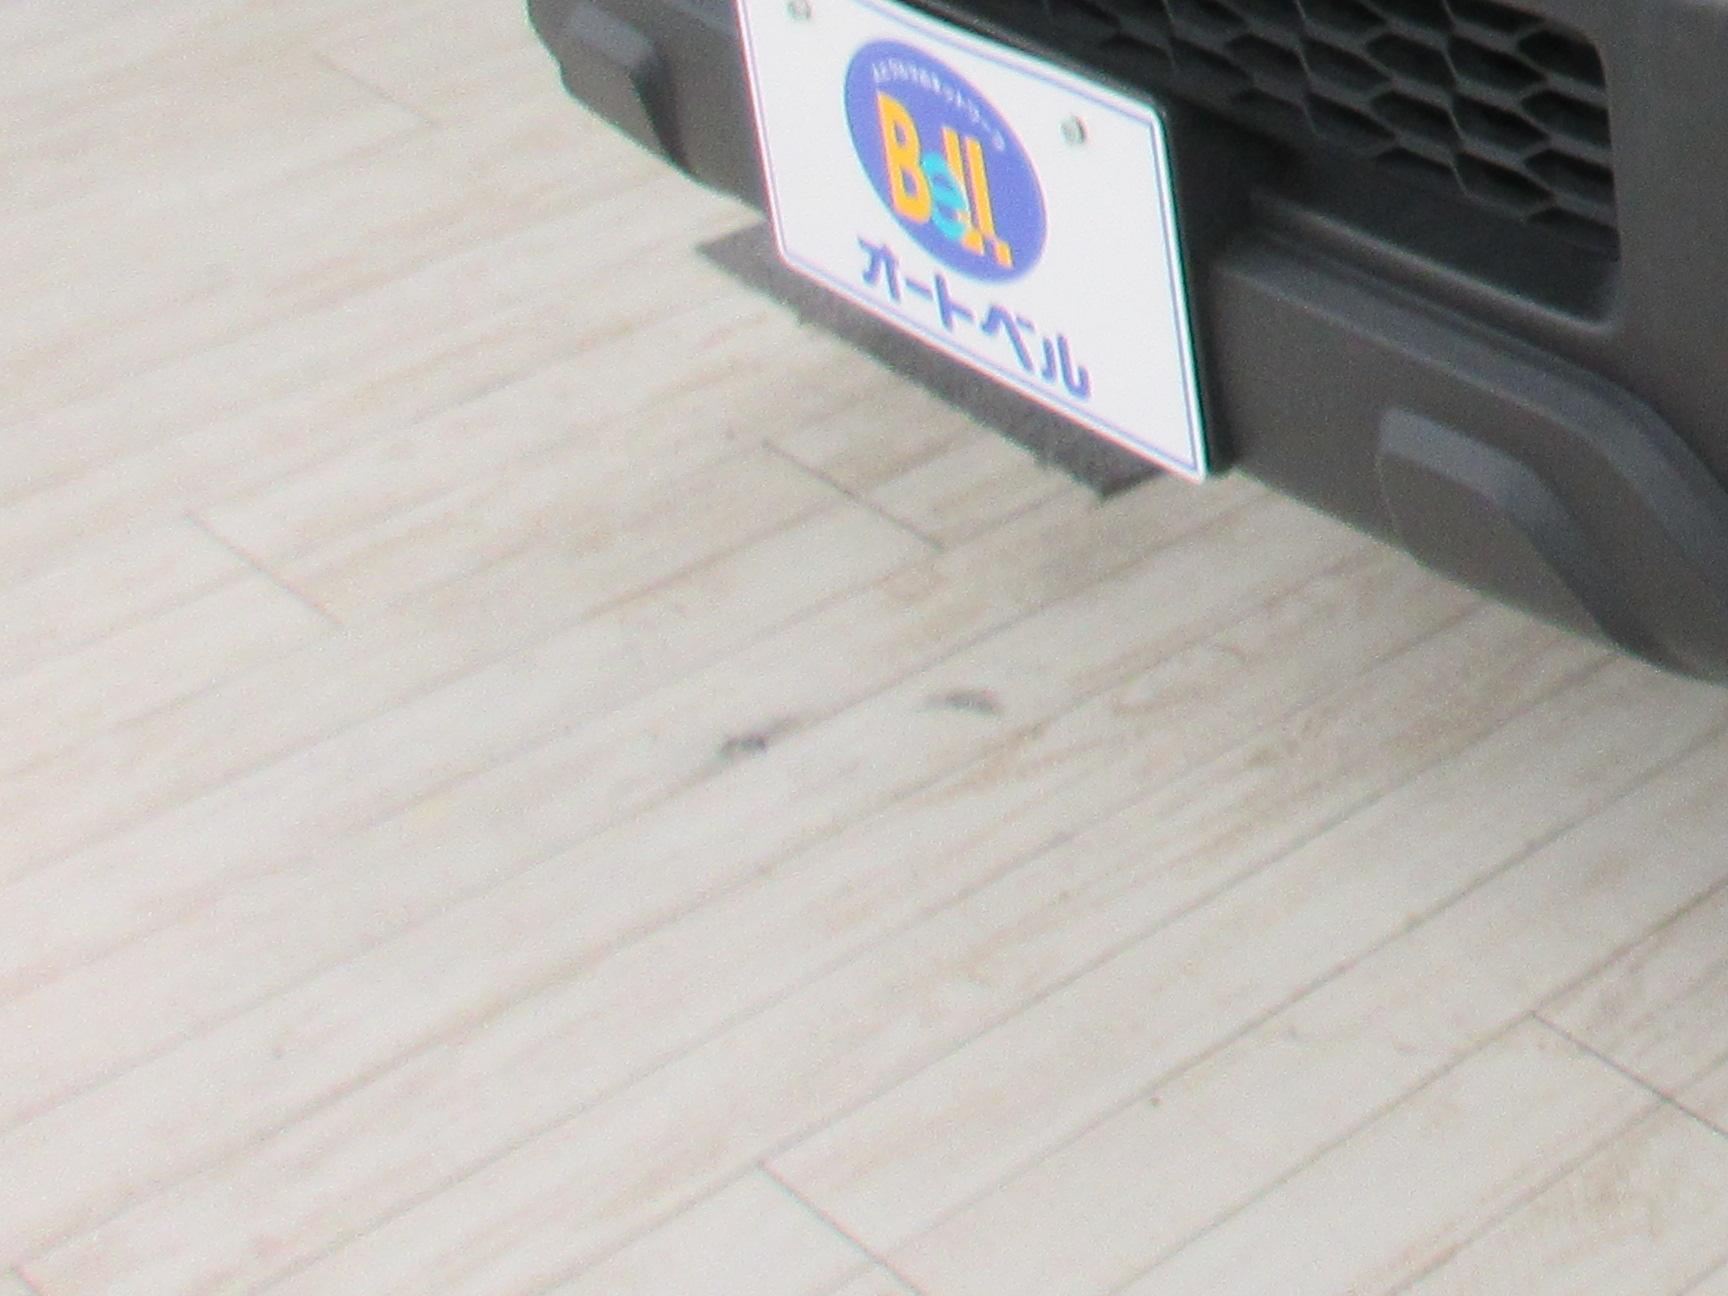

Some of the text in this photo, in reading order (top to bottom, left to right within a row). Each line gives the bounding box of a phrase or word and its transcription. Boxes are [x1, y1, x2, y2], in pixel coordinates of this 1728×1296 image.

[857, 234, 1093, 402] オートベル
